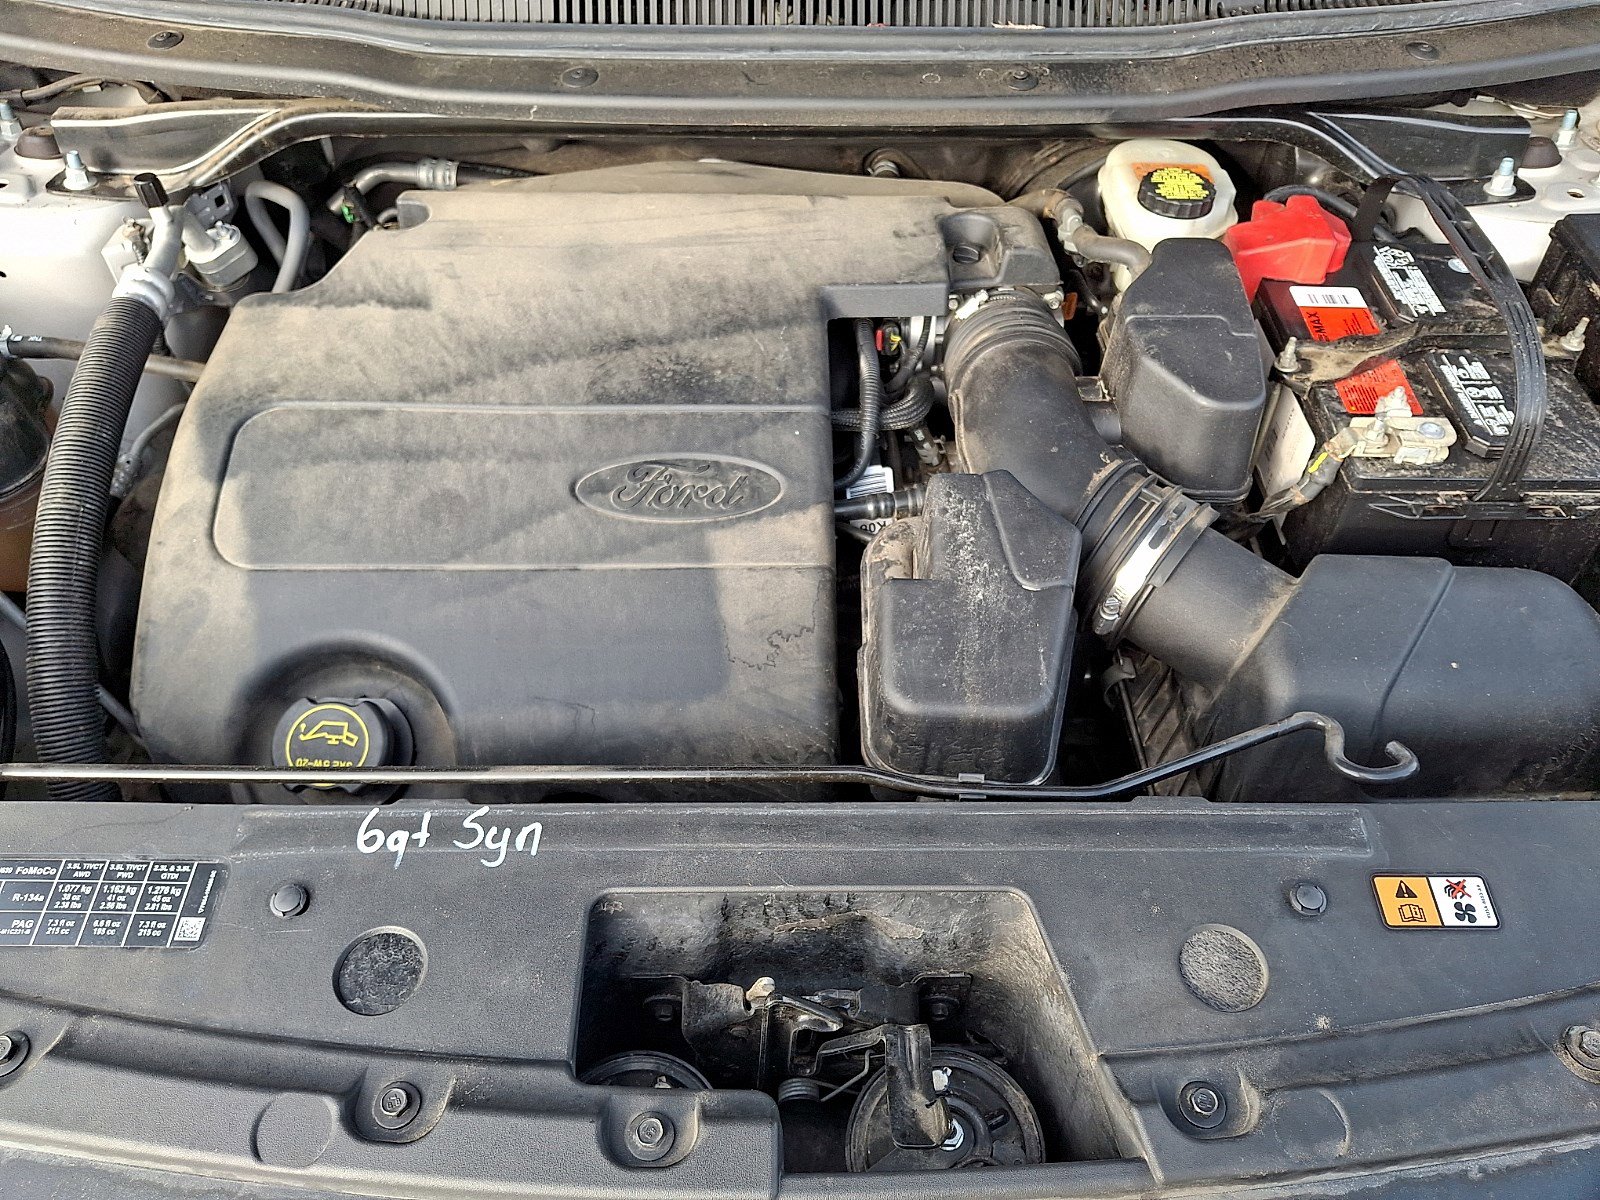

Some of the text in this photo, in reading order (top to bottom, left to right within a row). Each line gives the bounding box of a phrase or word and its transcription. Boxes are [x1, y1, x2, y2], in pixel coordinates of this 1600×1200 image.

[1306, 311, 1326, 334] MAX
[611, 461, 748, 511] Ford
[356, 805, 542, 869] 6qt Syn
[15, 866, 57, 875] FoMoCo
[72, 870, 91, 878] AWD
[116, 871, 134, 879] FWD
[58, 883, 92, 895] 1.077 kg
[103, 884, 138, 896] 1.162 kg
[170, 886, 182, 897] kg
[12, 892, 45, 902] R-134a
[106, 893, 117, 902] 41
[151, 894, 162, 903] 45
[70, 901, 82, 909] lbs
[115, 902, 128, 910] lbs
[160, 903, 173, 911] lbs
[11, 919, 35, 929] PAG
[47, 919, 60, 927] 7.3
[138, 920, 152, 929] 7.3
[45, 926, 61, 935] 215
[106, 928, 117, 936] cc
[137, 928, 163, 937] 215 cc
